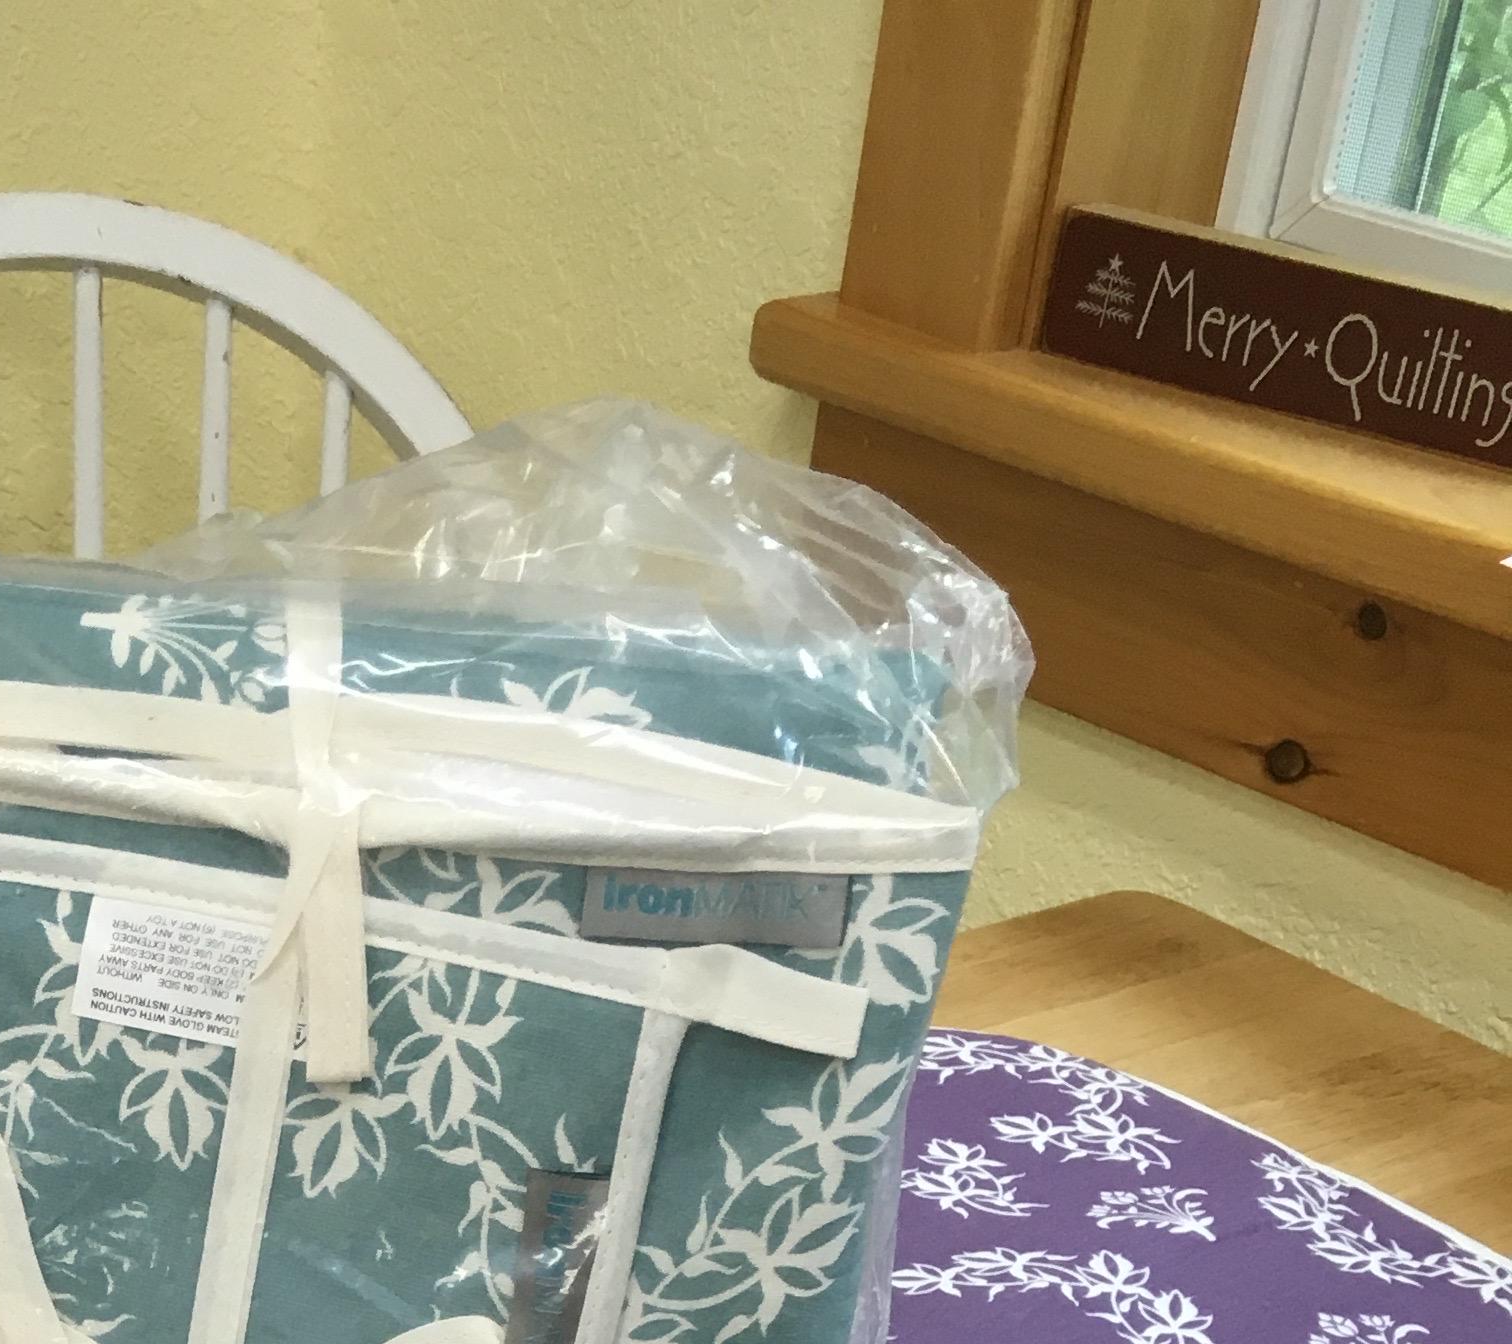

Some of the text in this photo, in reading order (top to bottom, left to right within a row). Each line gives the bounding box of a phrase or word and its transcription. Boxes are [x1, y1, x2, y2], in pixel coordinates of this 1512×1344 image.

[1136, 260, 1512, 447] Merry Quilting
[97, 953, 129, 967] AWAY
[130, 959, 164, 975] PARTS
[96, 965, 143, 982] WITHOUT
[91, 986, 170, 1012] INSTRUCTIONS
[89, 998, 137, 1018] CAUTION
[138, 1009, 166, 1023] WITH
[171, 1004, 212, 1020] SAFETY
[168, 1015, 204, 1031] GLOVE
